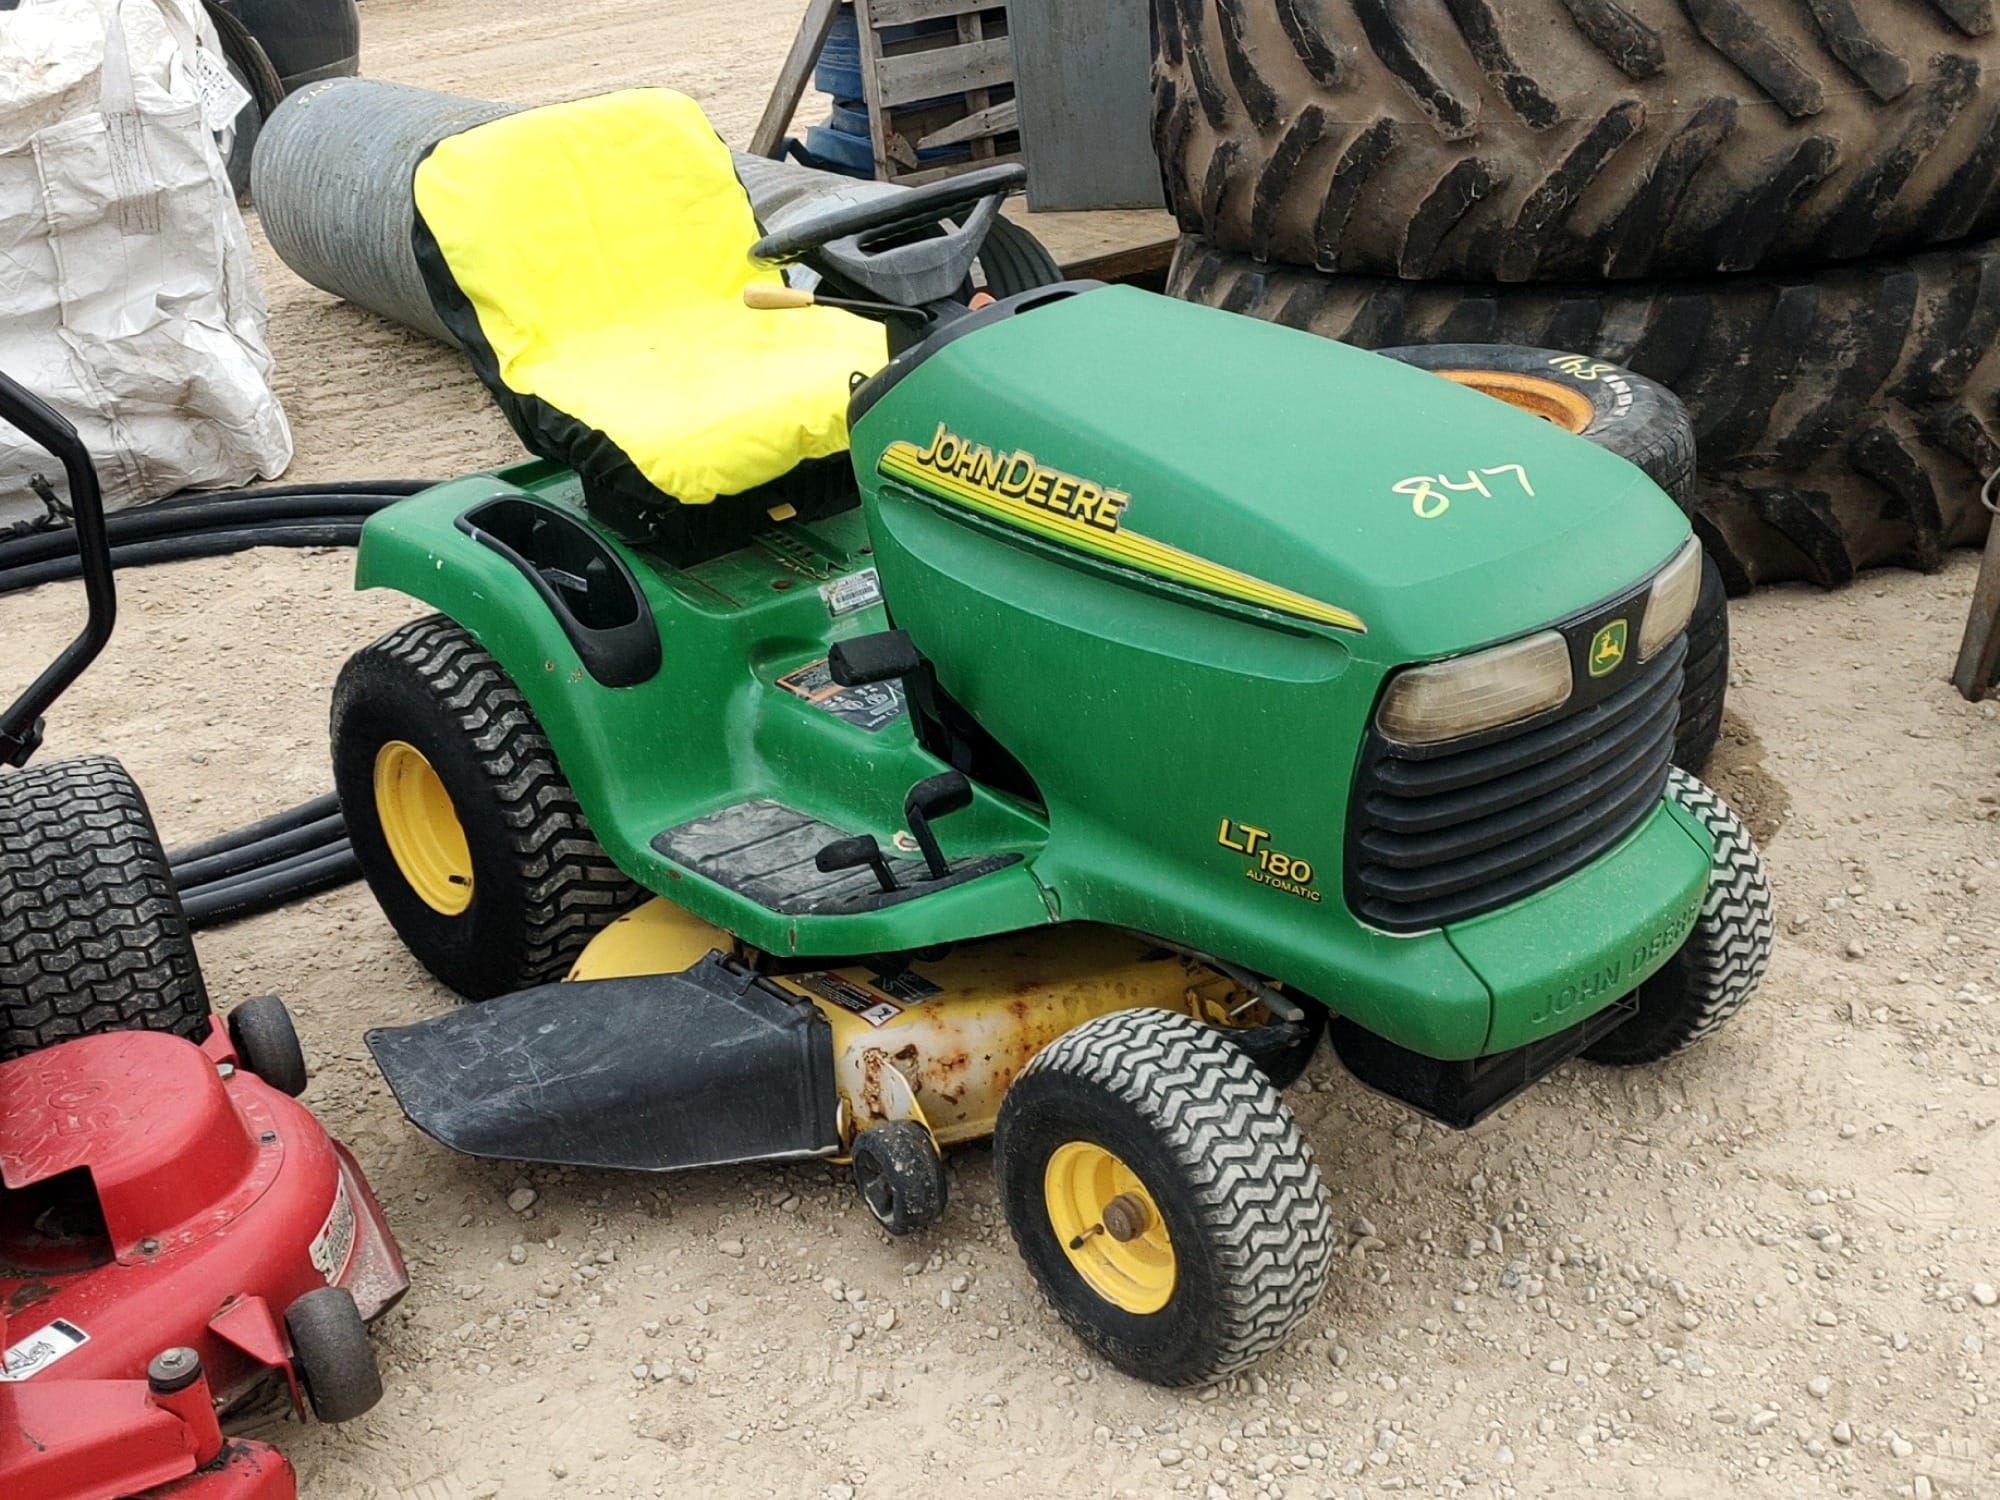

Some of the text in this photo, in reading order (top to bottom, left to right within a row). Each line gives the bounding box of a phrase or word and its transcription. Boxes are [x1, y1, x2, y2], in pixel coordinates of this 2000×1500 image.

[917, 422, 1131, 533] JOHN DEERE
[1391, 463, 1536, 519] 847
[1245, 869, 1322, 902] AUTOMATIC
[1532, 960, 1621, 1024] JOHN
